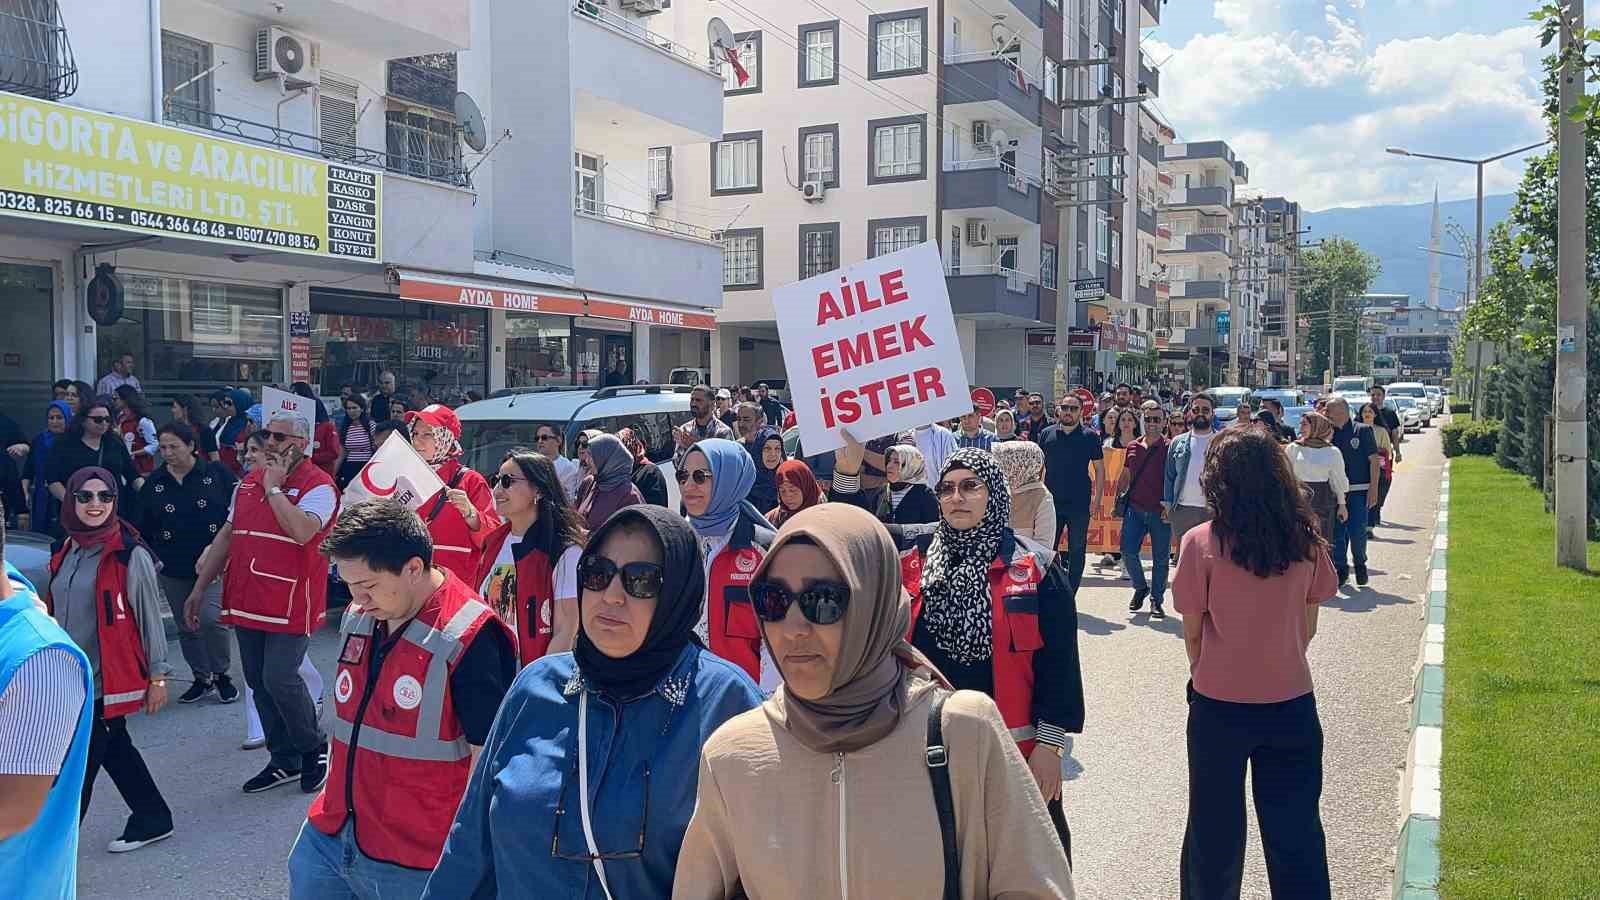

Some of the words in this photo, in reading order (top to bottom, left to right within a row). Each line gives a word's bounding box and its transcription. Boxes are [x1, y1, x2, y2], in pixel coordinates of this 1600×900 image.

[147, 140, 182, 172] ve
[191, 142, 320, 196] ARACILIK
[332, 183, 371, 198] KASKO
[336, 199, 366, 212] DASK
[0, 191, 40, 212] 0328.
[44, 198, 72, 216] 825
[75, 204, 93, 219] 66
[97, 206, 114, 222] 15
[130, 210, 164, 229] 0544
[166, 217, 190, 232] 366
[192, 221, 208, 235] 48
[210, 223, 225, 237] 48
[236, 226, 264, 242] 0507
[266, 231, 286, 245] 470
[288, 234, 301, 247] 88
[303, 236, 317, 249] 54
[332, 213, 373, 228] YANGIN
[334, 228, 372, 242] KONUT
[459, 288, 494, 306] AYDA
[503, 292, 538, 310] HOME
[816, 269, 909, 326] AİLE
[630, 307, 654, 321] AYDA
[659, 311, 684, 325] HOME
[811, 314, 936, 378] EMEK
[819, 367, 946, 428] İSTER
